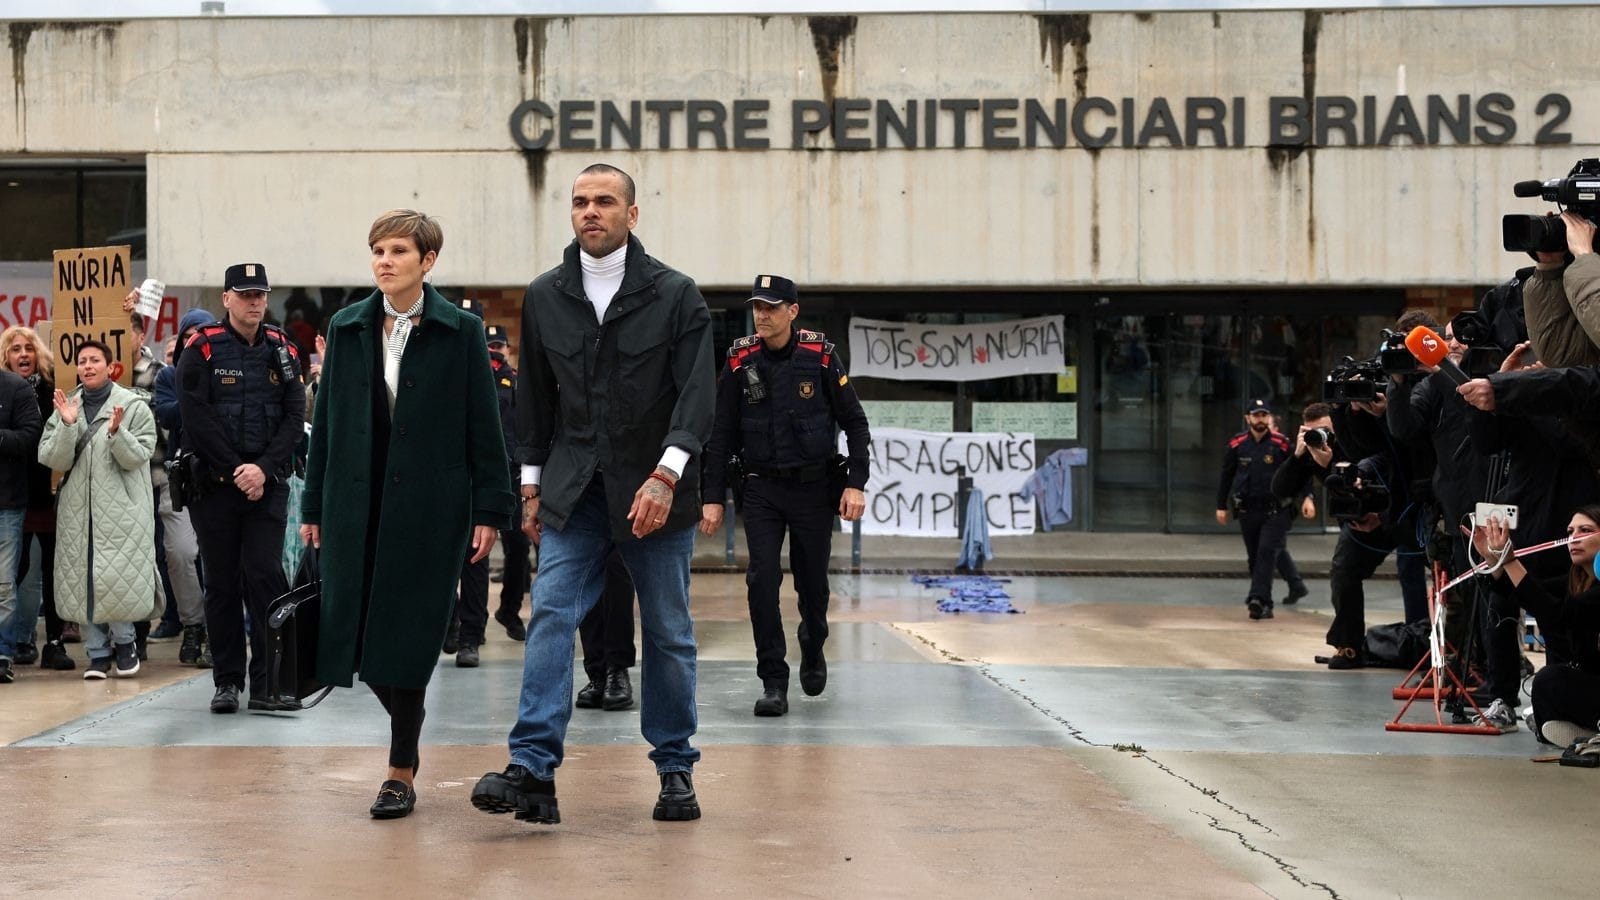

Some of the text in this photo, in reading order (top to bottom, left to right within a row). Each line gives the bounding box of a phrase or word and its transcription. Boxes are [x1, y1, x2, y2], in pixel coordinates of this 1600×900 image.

[509, 92, 1572, 151] CENTRE PENITENCIARI BRIANS 2
[58, 252, 126, 292] NÚRIA
[73, 296, 94, 328] NI
[60, 329, 126, 366] OBT
[854, 324, 916, 370] TOTS
[985, 321, 1064, 364] NÚRIA
[214, 368, 244, 377] POLICIA
[864, 481, 1032, 531] ÓMPCE
